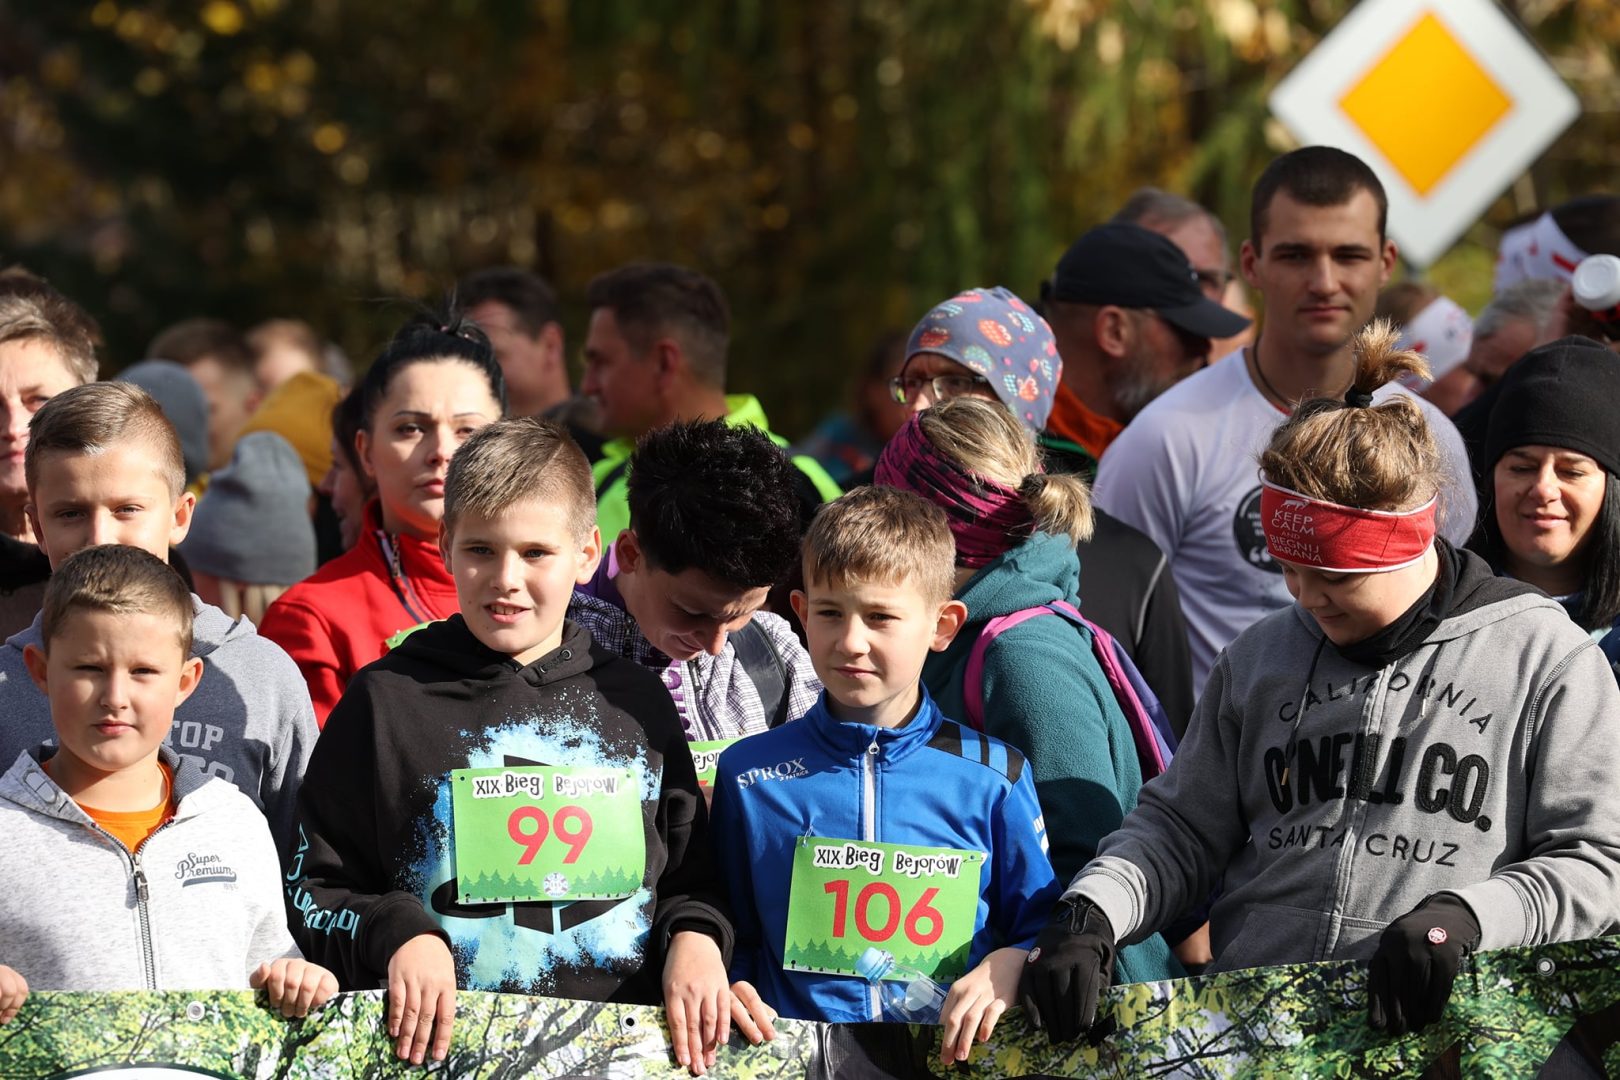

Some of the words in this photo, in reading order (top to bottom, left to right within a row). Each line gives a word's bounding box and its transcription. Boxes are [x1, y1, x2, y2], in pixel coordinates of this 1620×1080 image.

[1271, 518, 1314, 536] CALM
[1274, 509, 1313, 524] KEEP
[1269, 534, 1319, 553] BIEGNIJ
[1281, 531, 1300, 540] AND
[1278, 671, 1493, 734] CALIFORNIA
[476, 779, 500, 795] XIX
[505, 773, 541, 796] Bieg
[736, 757, 806, 789] SPROX
[1414, 742, 1492, 832] CO.
[507, 805, 594, 866] 99
[1268, 825, 1349, 850] SANTA
[1365, 833, 1460, 867] CRUZ
[175, 860, 234, 880] Premium
[188, 852, 222, 869] Super
[816, 848, 841, 865] XIX
[845, 846, 882, 872] Bieg
[824, 879, 944, 946] 106
